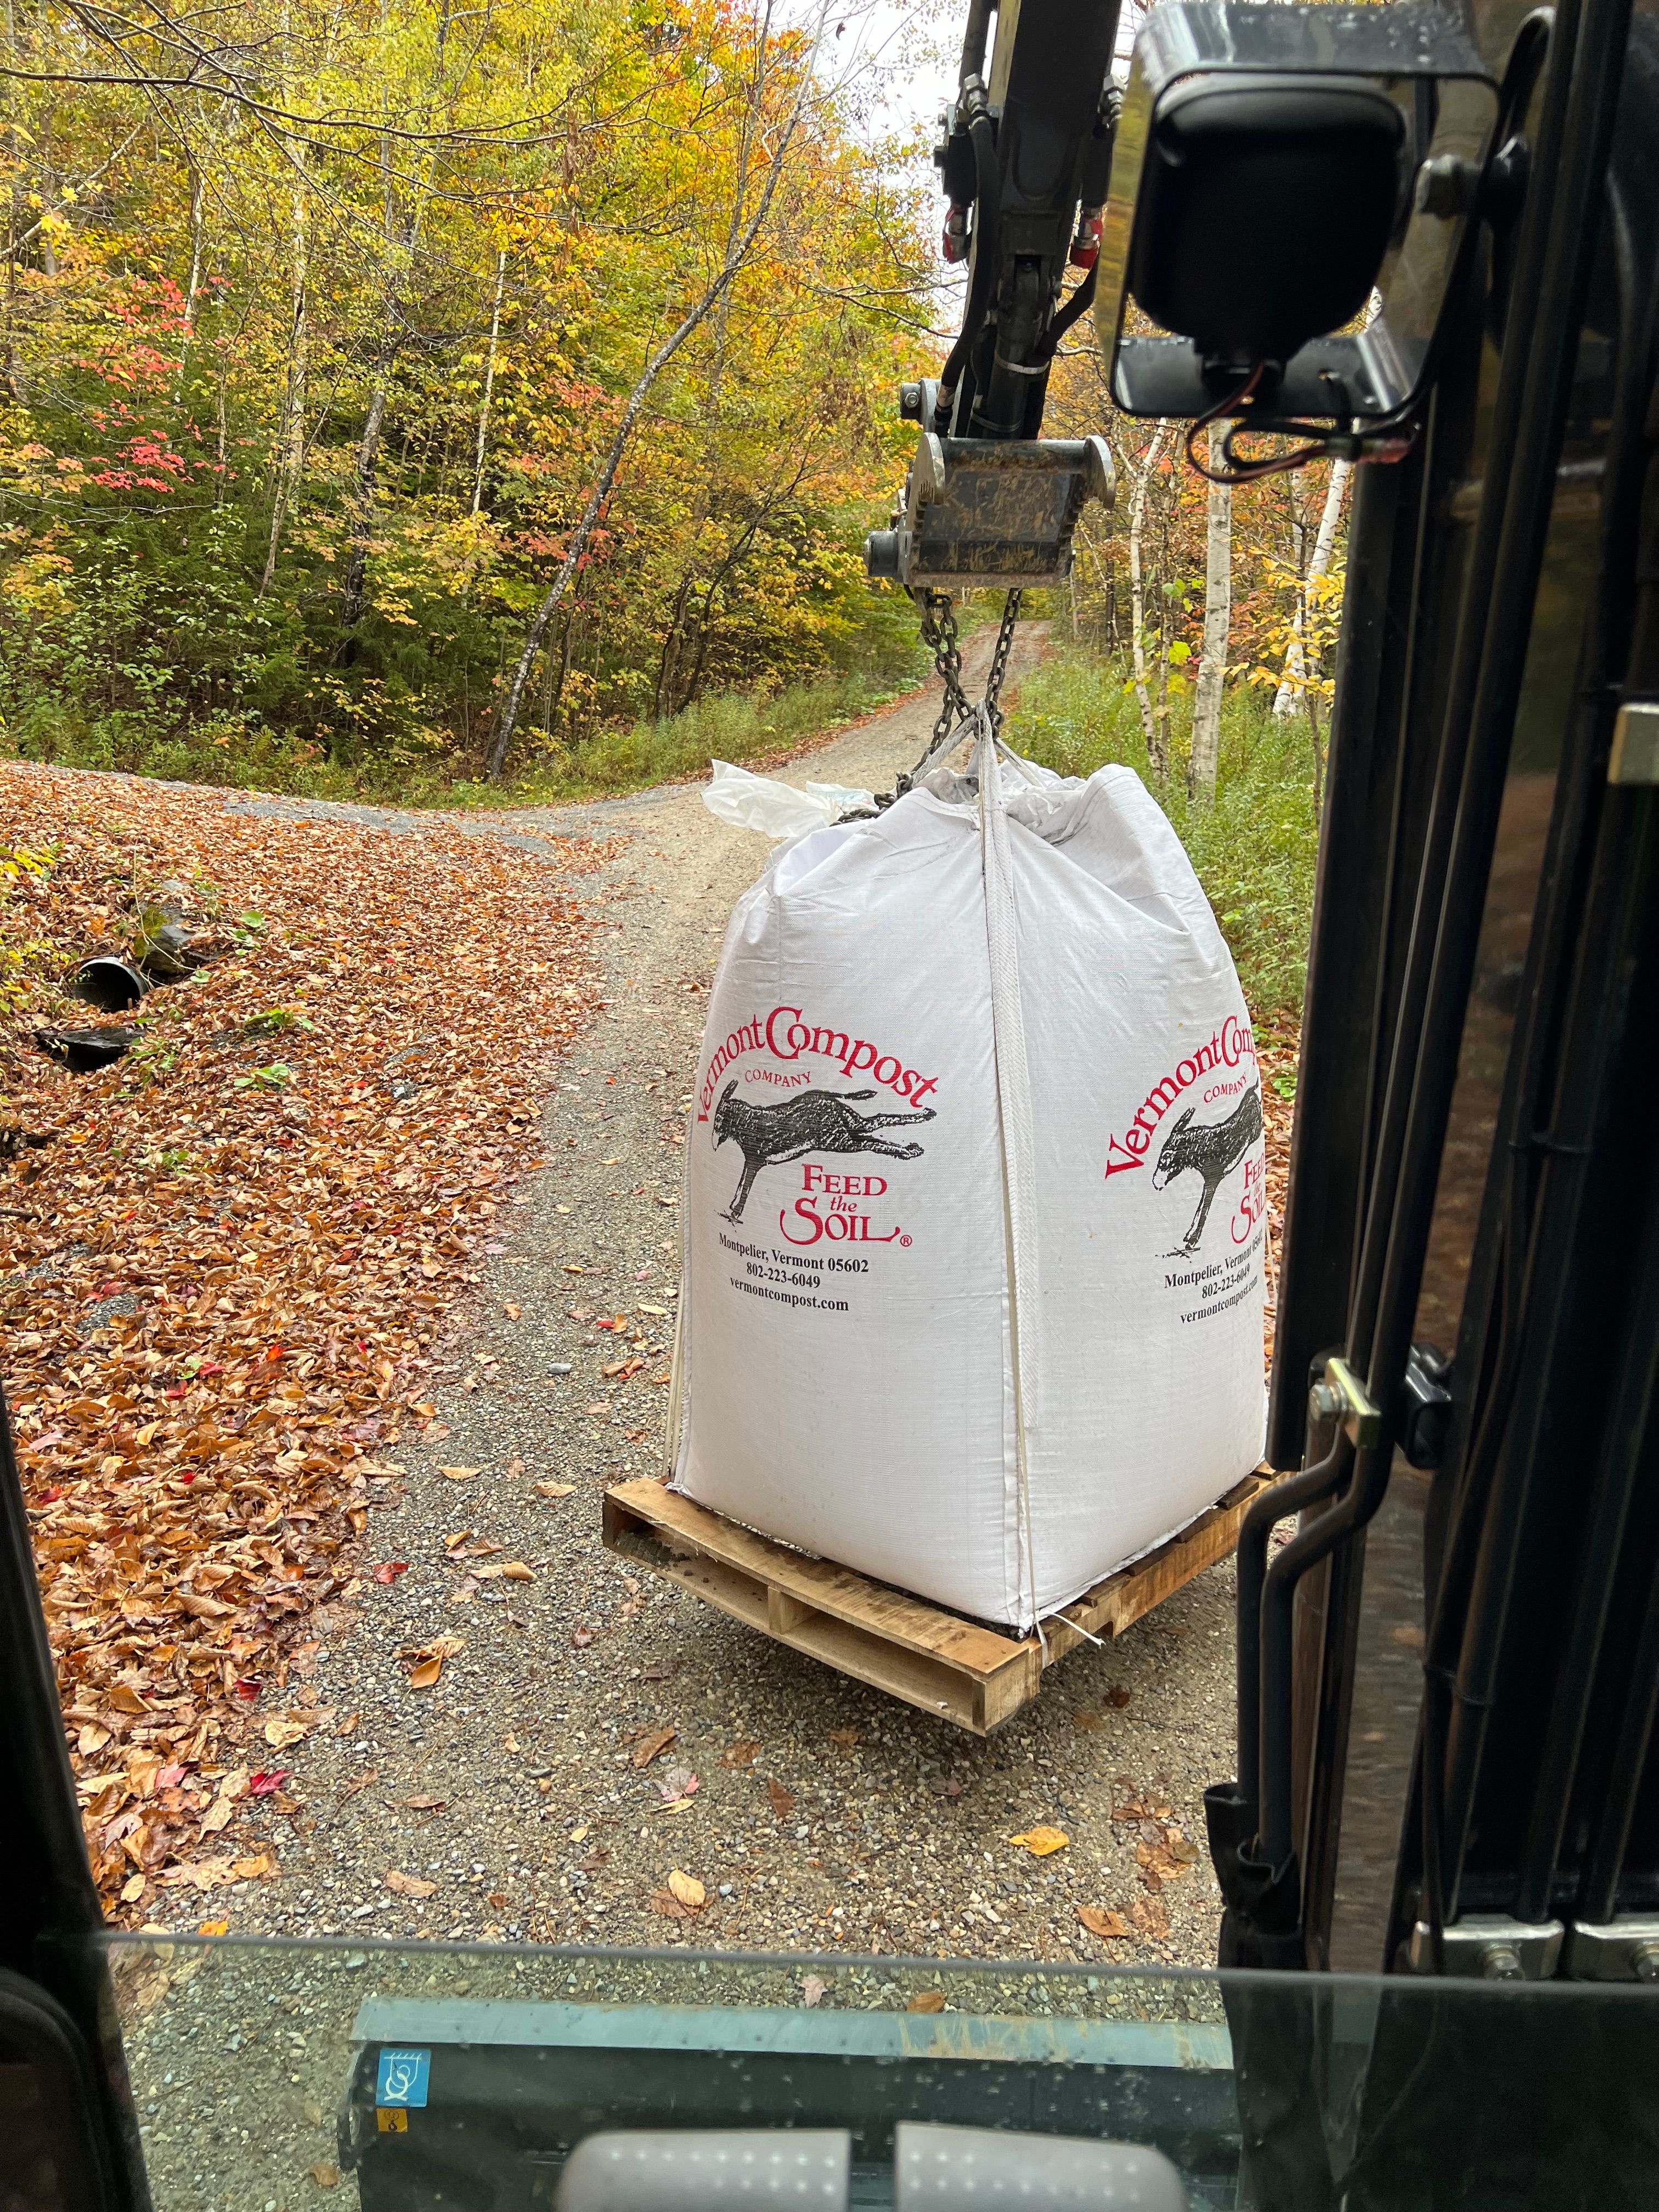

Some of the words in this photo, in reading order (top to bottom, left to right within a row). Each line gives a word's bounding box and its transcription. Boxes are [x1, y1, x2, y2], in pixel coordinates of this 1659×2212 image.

[698, 1014, 765, 1124] Vermont
[766, 1006, 939, 1108] Compost
[744, 1069, 811, 1087] COMPANY
[1204, 1072, 1246, 1103] COMPANY
[1105, 1031, 1222, 1180] Vermont
[801, 1163, 888, 1197] FEED
[830, 1197, 857, 1212] the
[719, 1232, 769, 1263] Montpelier,
[771, 1249, 825, 1271] Vermont
[828, 1257, 869, 1273] 05602
[1164, 1264, 1223, 1288] Montpelier,
[1224, 1244, 1252, 1270] Vermont
[746, 1262, 821, 1289] 802-223-6049
[1201, 1262, 1250, 1299] 802-223-6049
[730, 1277, 849, 1311] vermontcompost.com
